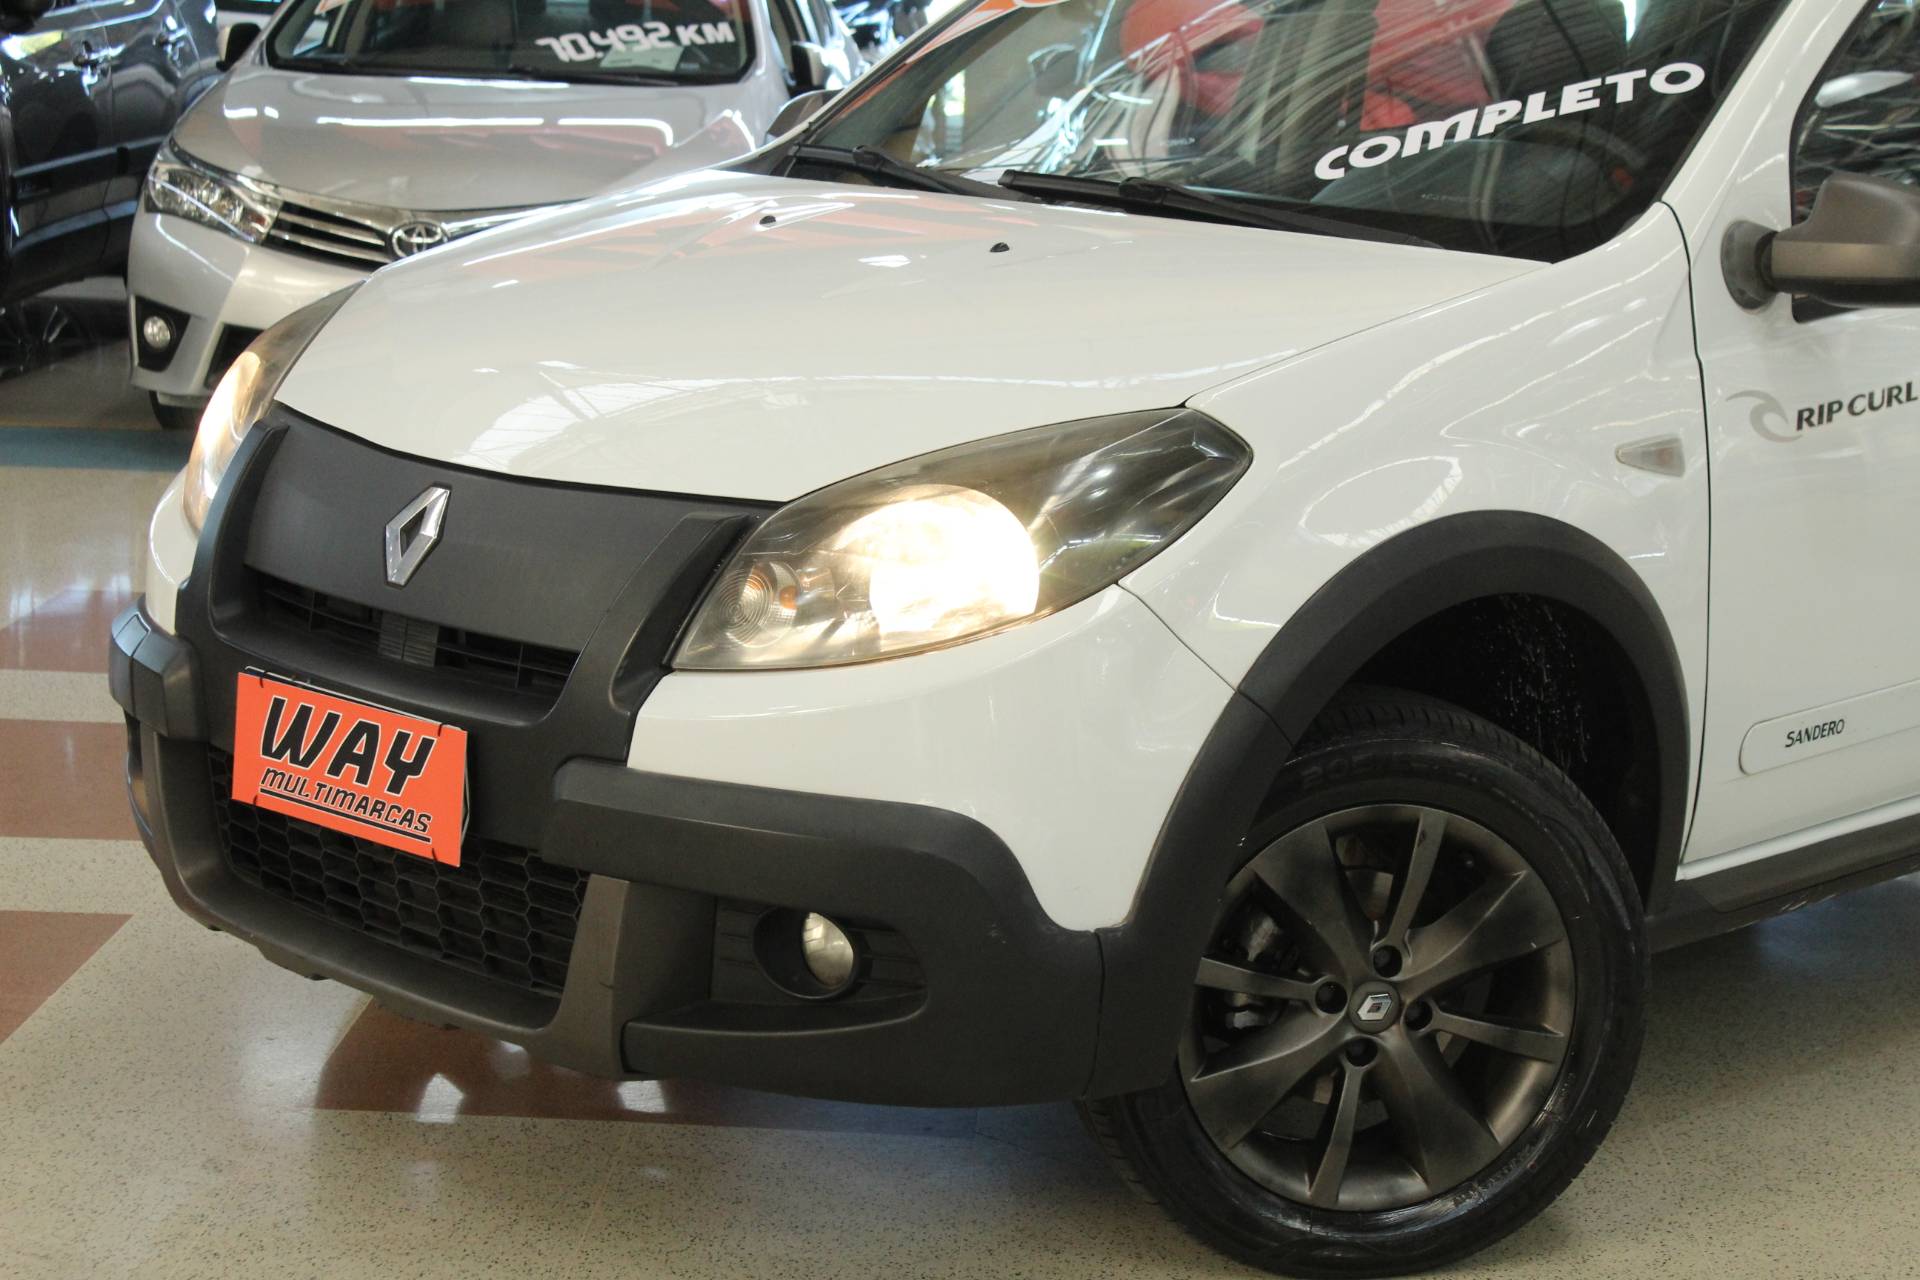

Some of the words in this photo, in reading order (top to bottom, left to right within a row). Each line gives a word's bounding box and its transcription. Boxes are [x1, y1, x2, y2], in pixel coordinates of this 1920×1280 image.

[675, 21, 736, 47] KM
[1314, 61, 1706, 180] COMPLETO
[1796, 400, 1843, 431] RIP
[1847, 381, 1918, 416] CURL
[260, 695, 438, 797] WAY
[1784, 718, 1846, 748] SANDERO
[259, 767, 432, 833] MULTIMARCAS
